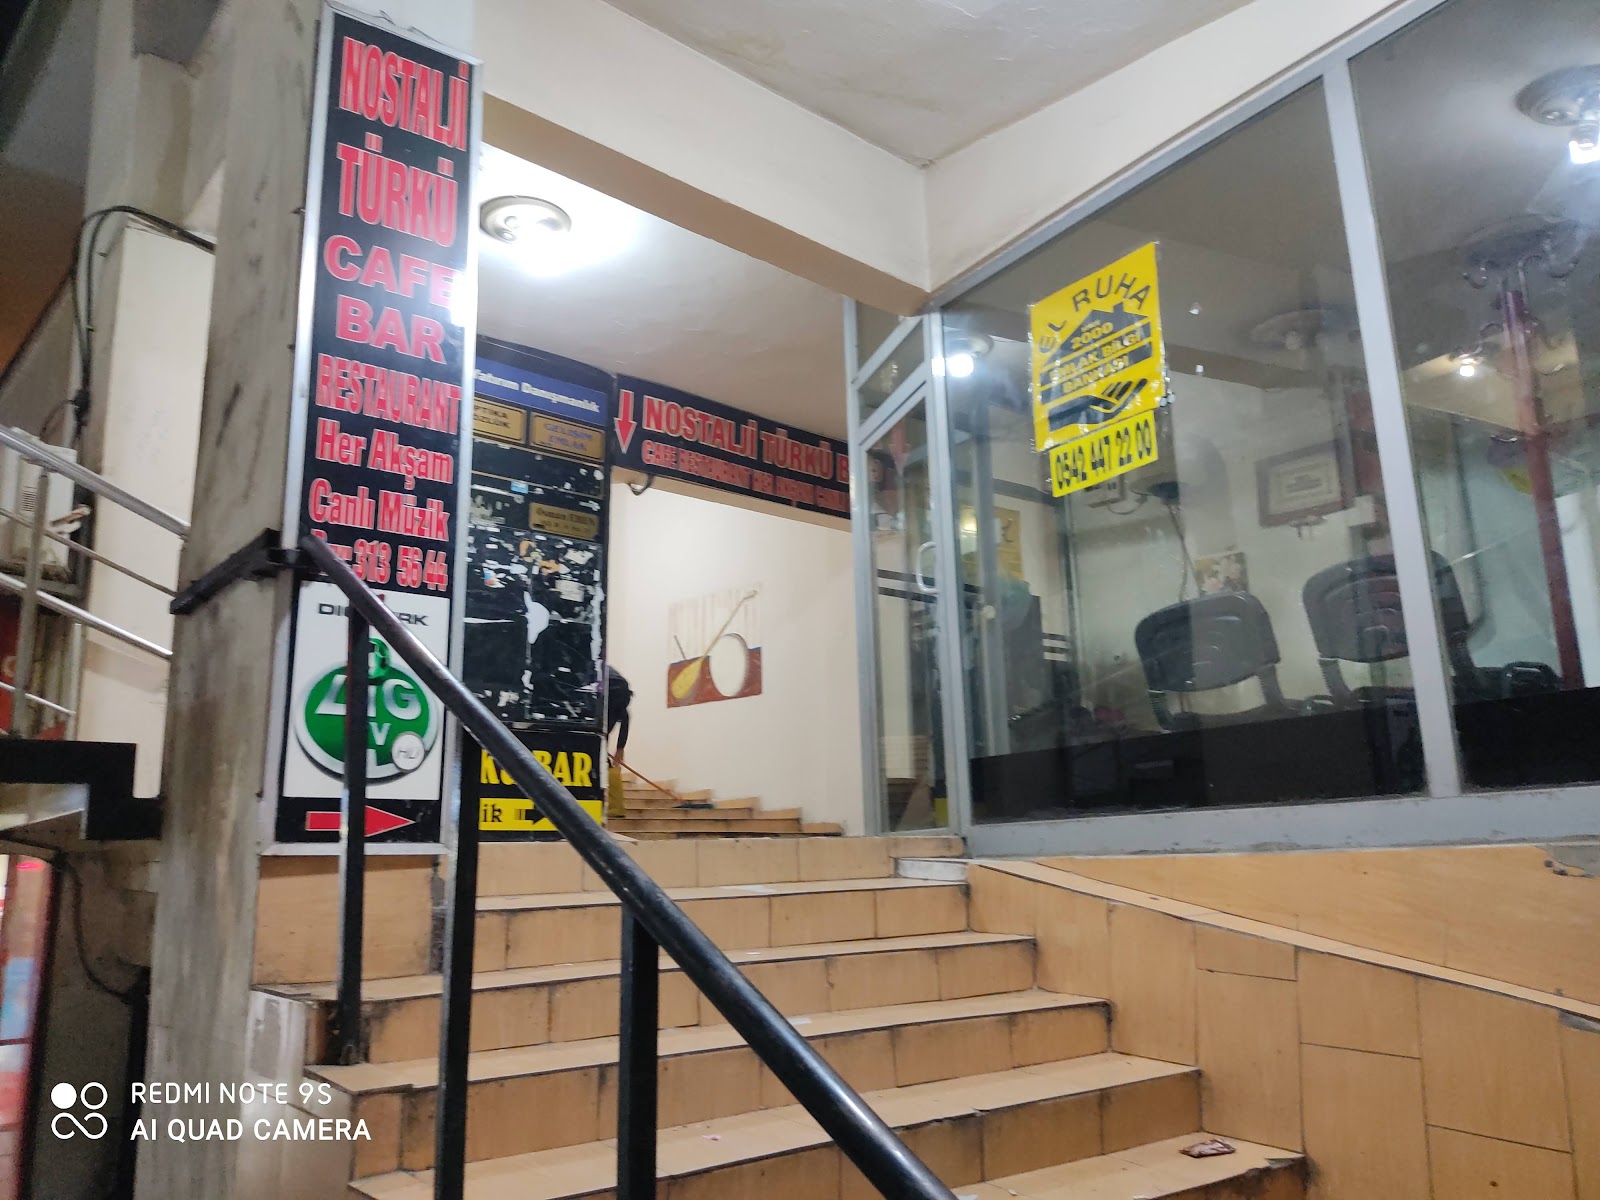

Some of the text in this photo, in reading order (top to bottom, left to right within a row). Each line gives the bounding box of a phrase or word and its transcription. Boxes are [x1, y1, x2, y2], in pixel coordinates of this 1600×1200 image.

[339, 36, 468, 151] NOSTALJİ
[337, 132, 457, 247] TÜRKÜ
[324, 235, 455, 307] CAFE
[1072, 272, 1151, 312] RUHA
[336, 294, 447, 364] BAR
[1071, 322, 1114, 350] 2000
[315, 352, 462, 435] RESTAURANT
[315, 416, 454, 490] Her Akşam
[643, 394, 758, 460] NOSTALJİ
[760, 428, 833, 480] TÜRKÜ
[1056, 418, 1152, 490] 0542 447 22 00
[308, 477, 450, 542] Canlı Müzik
[396, 544, 423, 588] 56
[423, 549, 449, 592] 44
